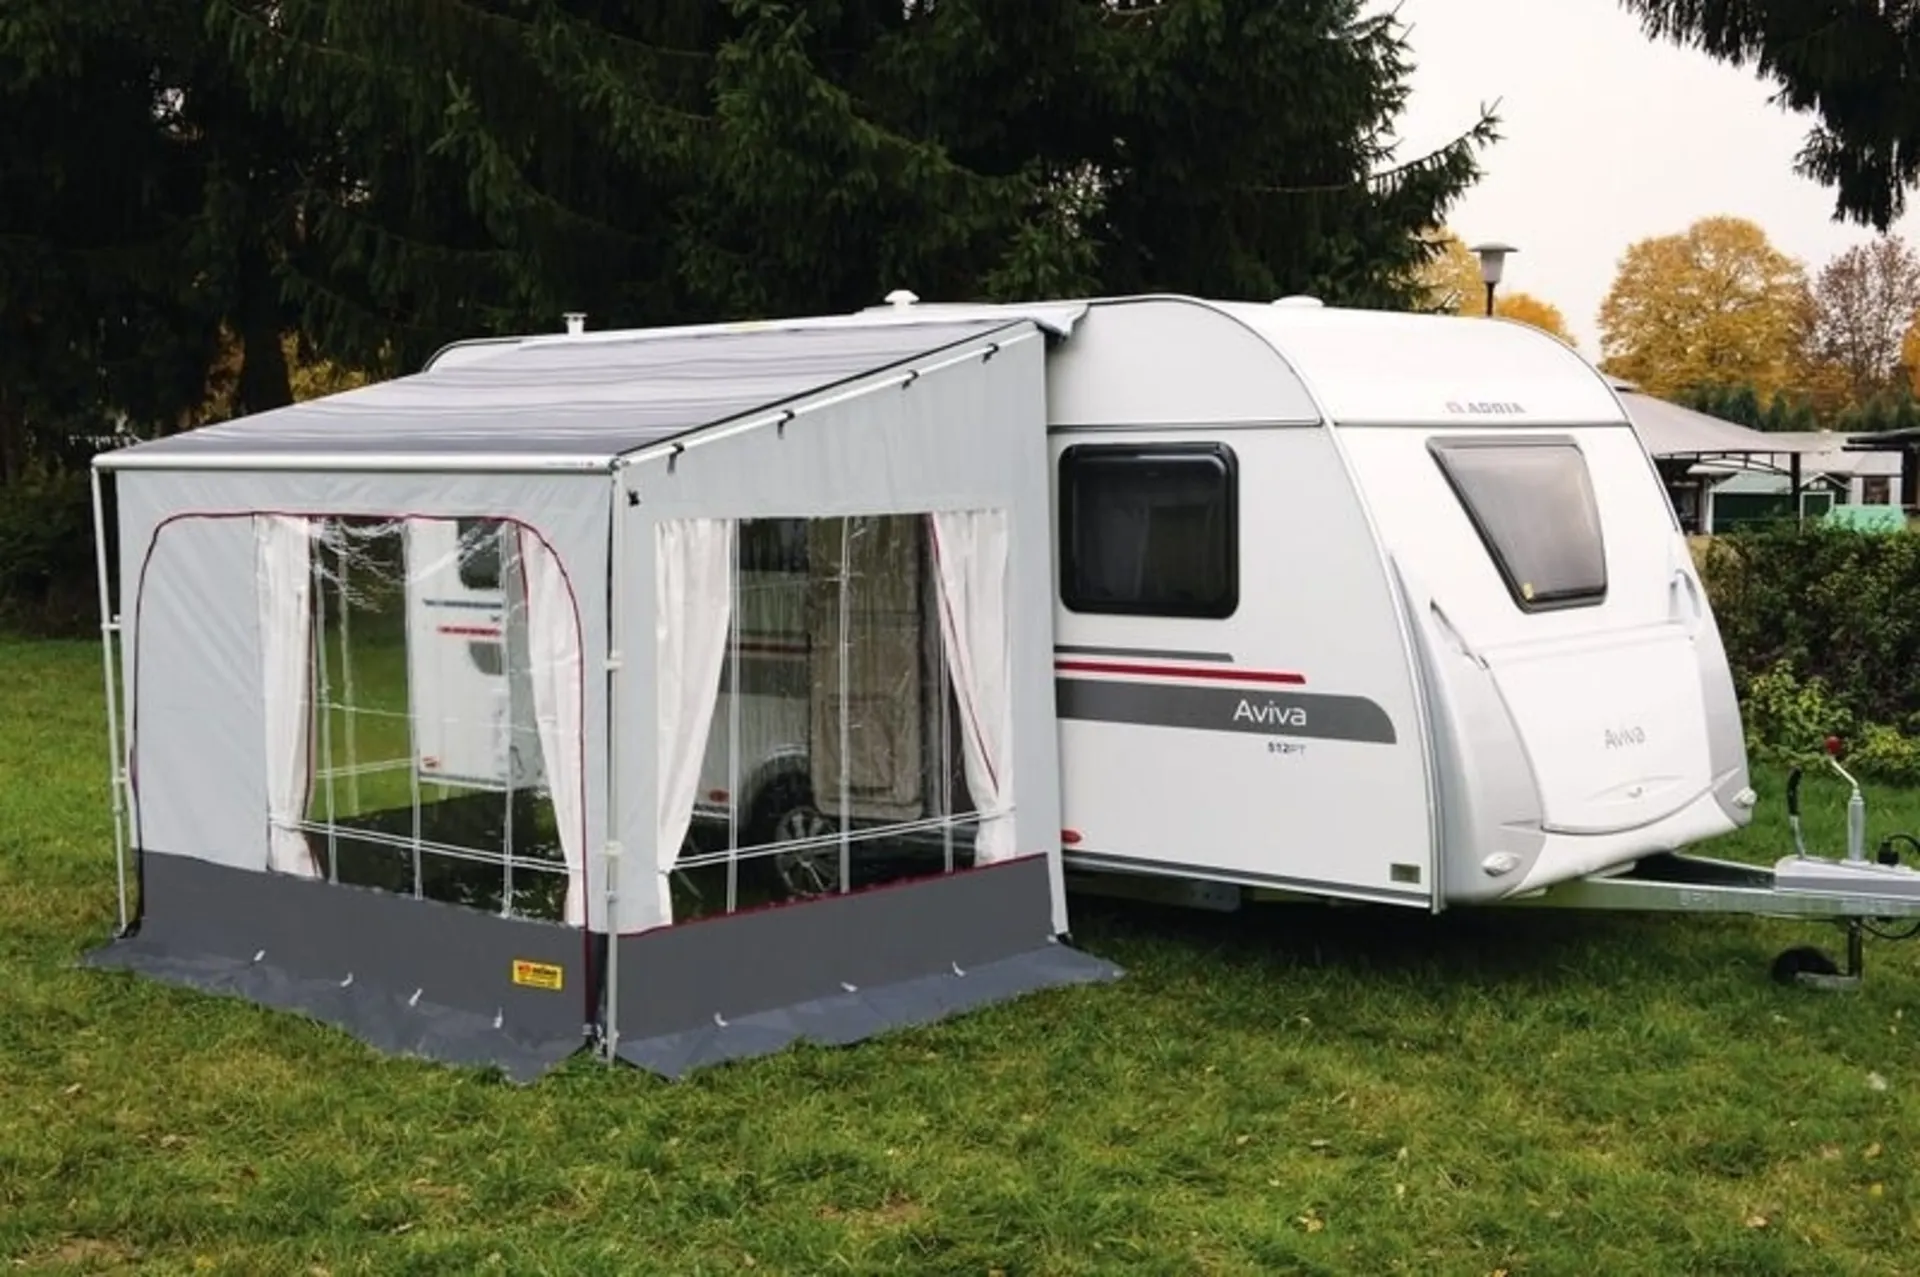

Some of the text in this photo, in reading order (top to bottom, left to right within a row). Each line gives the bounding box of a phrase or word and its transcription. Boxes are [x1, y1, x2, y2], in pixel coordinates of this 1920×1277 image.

[1467, 402, 1526, 414] ADRIA
[1233, 699, 1307, 726] Aviva
[1605, 725, 1646, 750] Aviva
